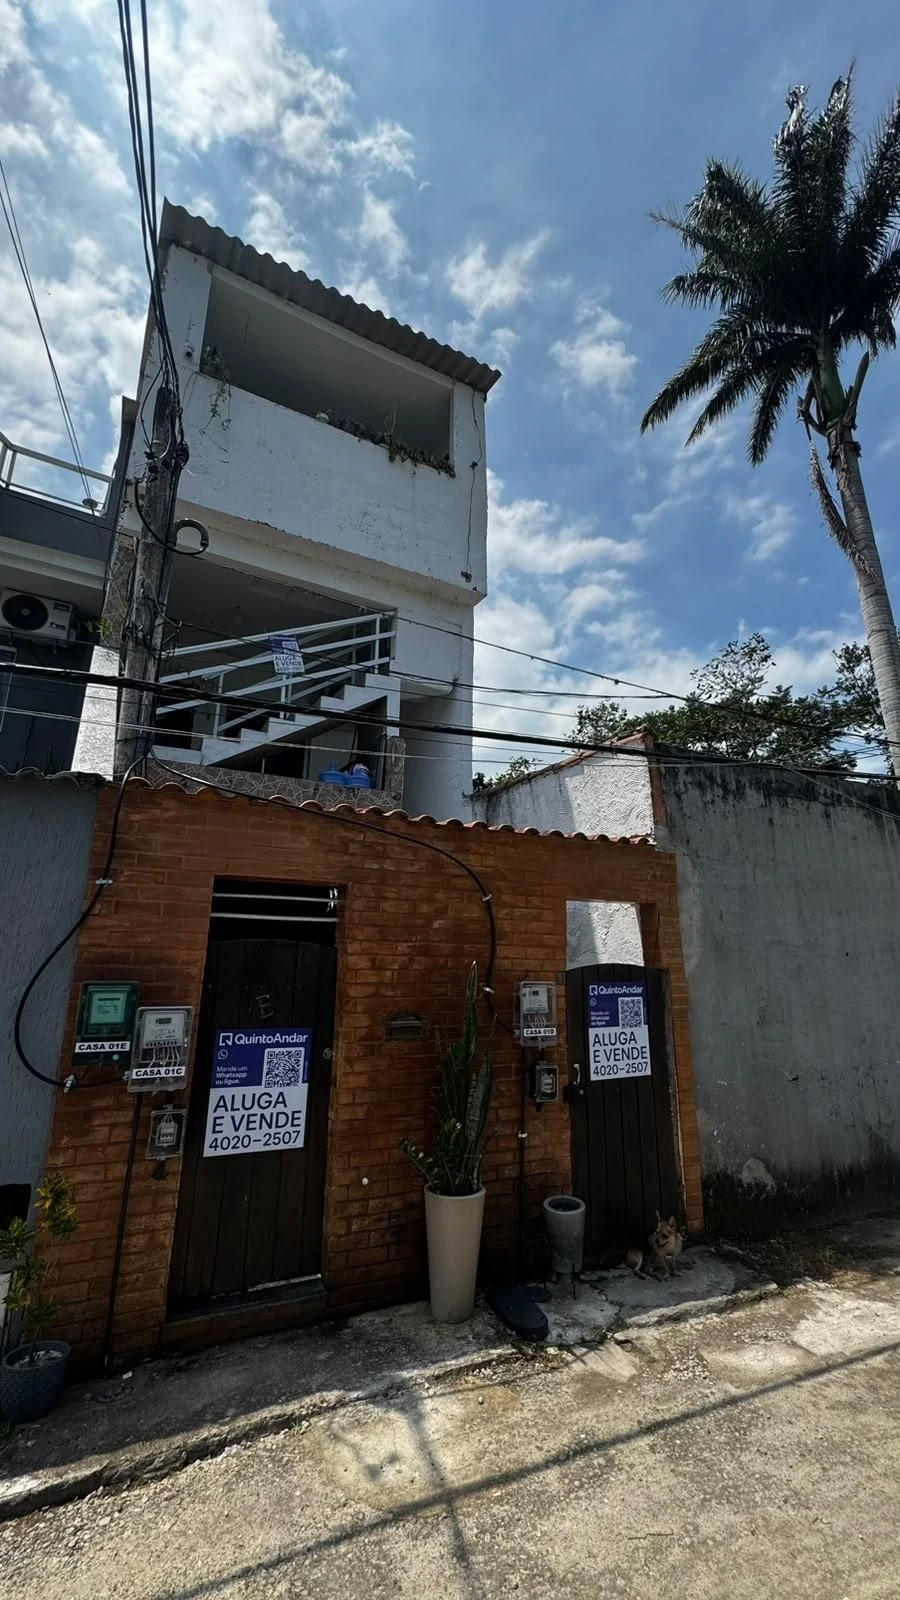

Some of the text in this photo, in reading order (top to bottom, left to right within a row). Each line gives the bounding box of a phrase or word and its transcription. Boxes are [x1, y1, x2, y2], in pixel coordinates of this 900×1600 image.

[598, 985, 643, 995] QuintoAndar
[78, 1042, 127, 1051] CASA 01E
[234, 1032, 309, 1046] QuintoAndar
[592, 1031, 637, 1047] ALUGA
[593, 1046, 648, 1063] E VENDE
[135, 1068, 183, 1077] CASA 01C
[593, 1062, 649, 1077] 4020-2507
[213, 1091, 288, 1114] ALUGA
[212, 1110, 302, 1134] E VENDE
[209, 1130, 301, 1152] 4020-2507
